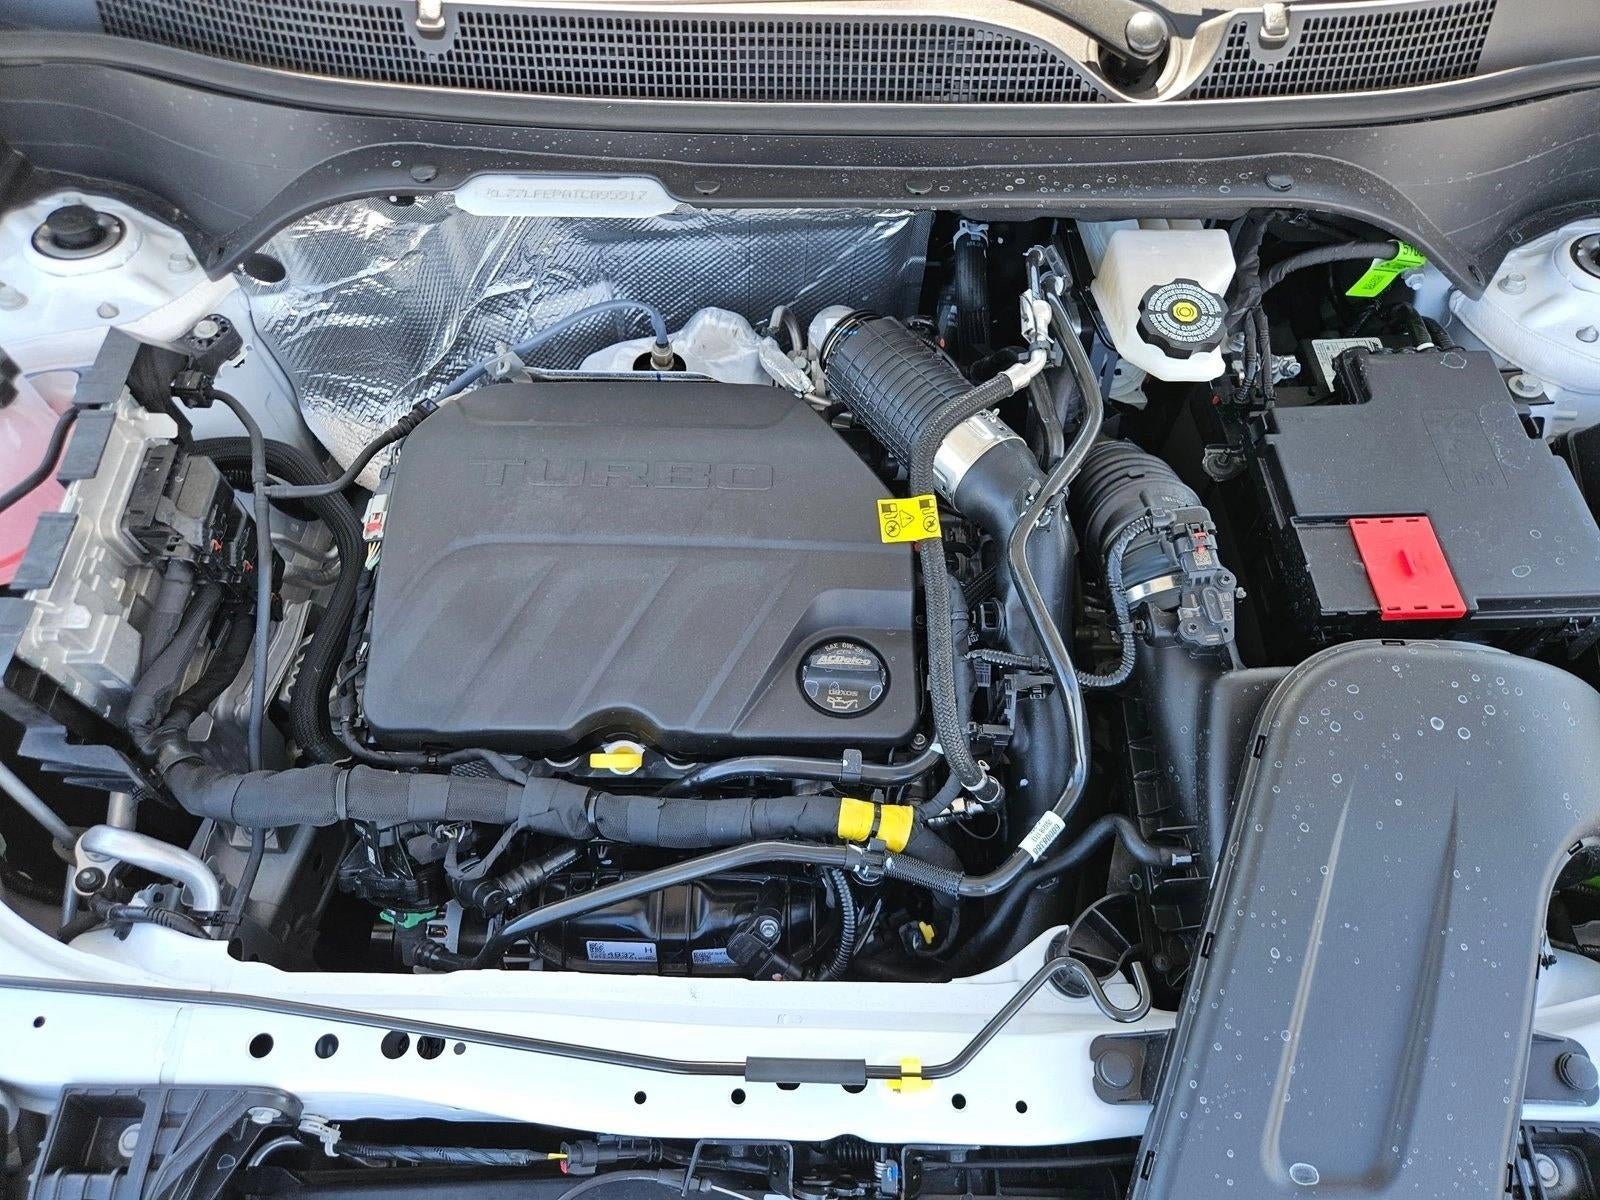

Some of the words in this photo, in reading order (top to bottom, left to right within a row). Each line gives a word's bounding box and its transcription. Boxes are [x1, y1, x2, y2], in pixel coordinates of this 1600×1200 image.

[469, 459, 774, 491] TURBO
[825, 642, 839, 652] SAE
[816, 654, 872, 666] ACDelco
